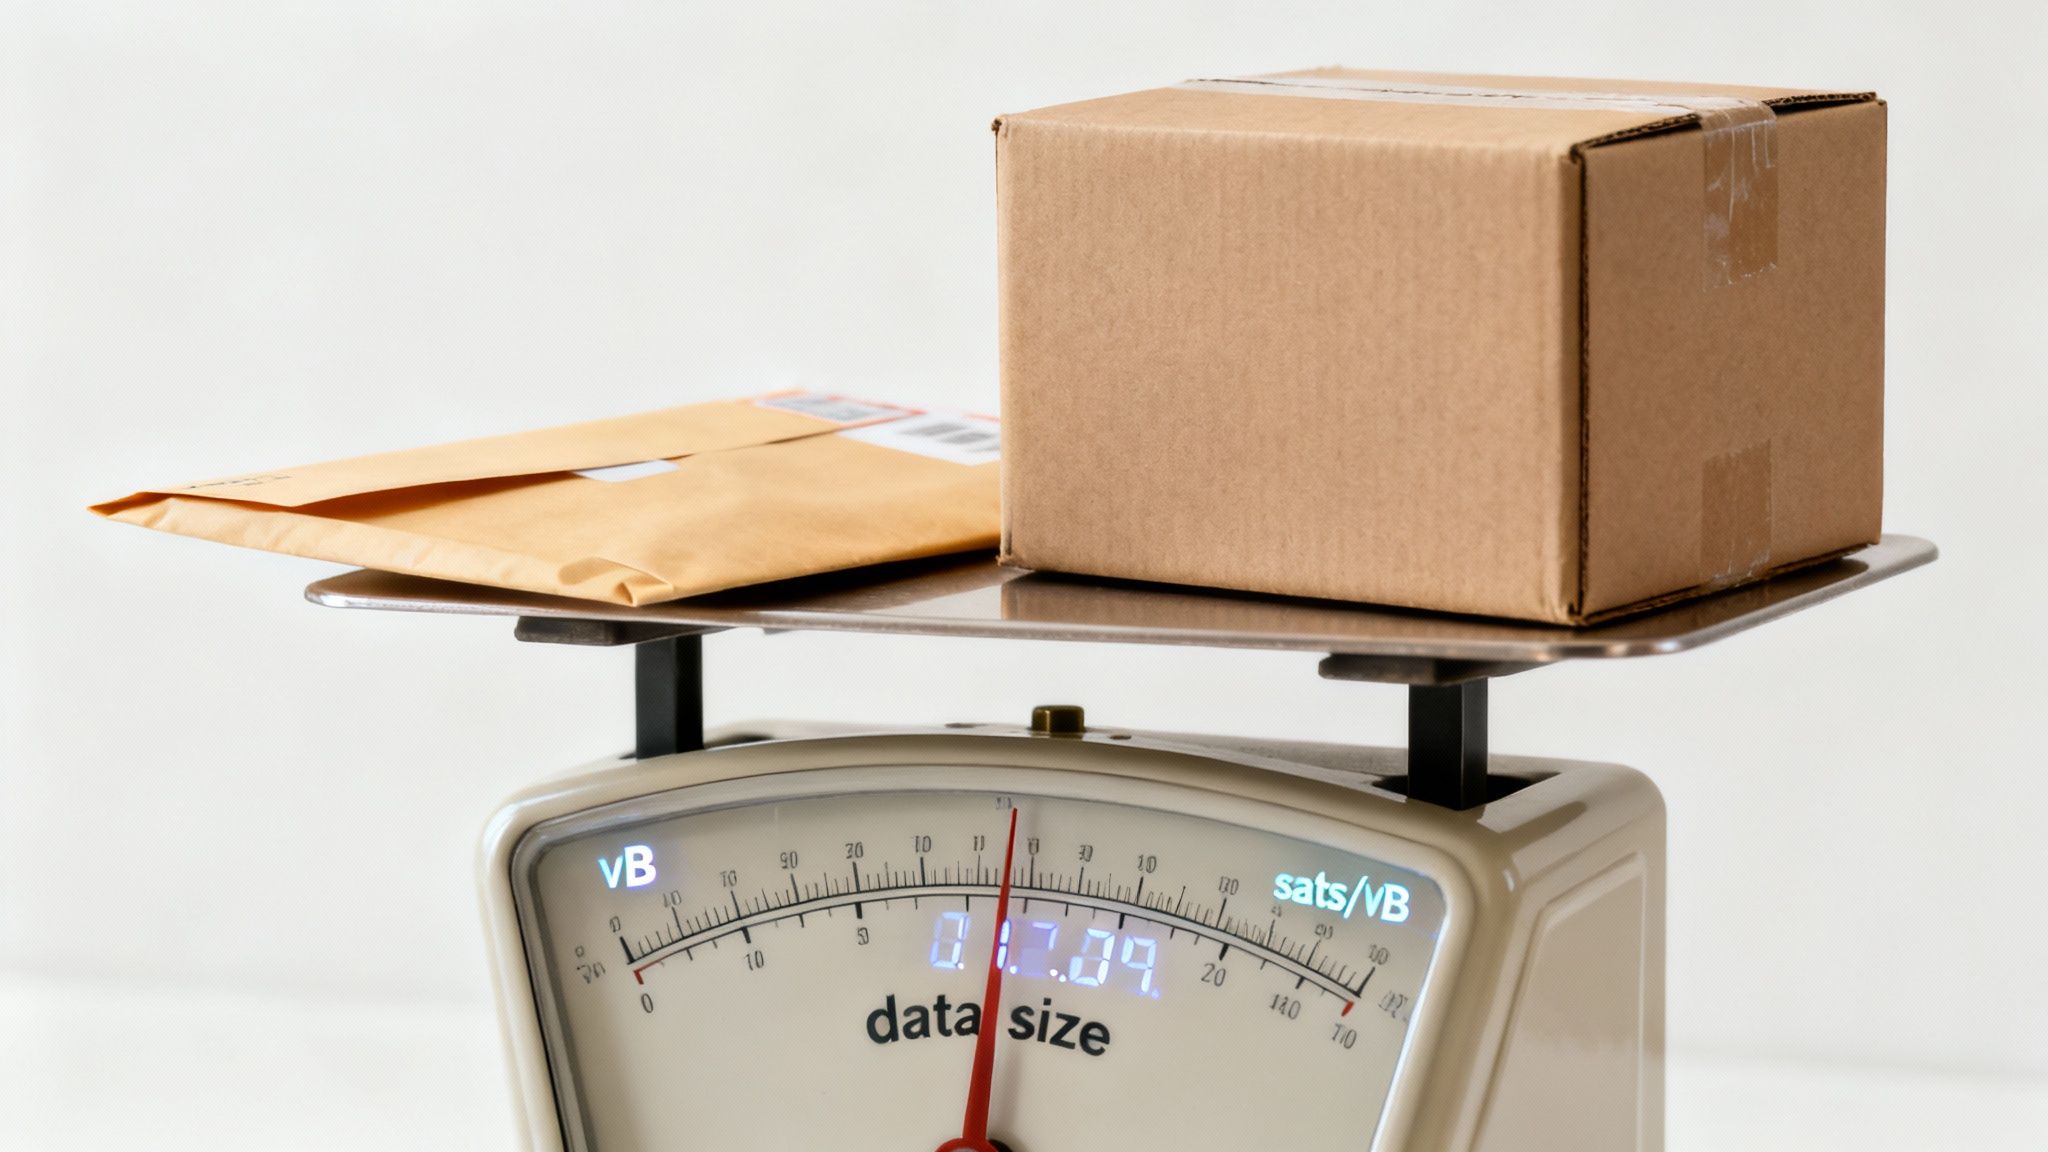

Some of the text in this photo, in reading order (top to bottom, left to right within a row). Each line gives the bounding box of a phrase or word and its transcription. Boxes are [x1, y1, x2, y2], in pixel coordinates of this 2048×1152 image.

[598, 844, 657, 889] vB
[1273, 871, 1410, 922] sats/vB
[745, 951, 764, 970] 10
[1201, 963, 1226, 987] 20
[641, 993, 653, 1013] 0
[866, 994, 1110, 1056] data size
